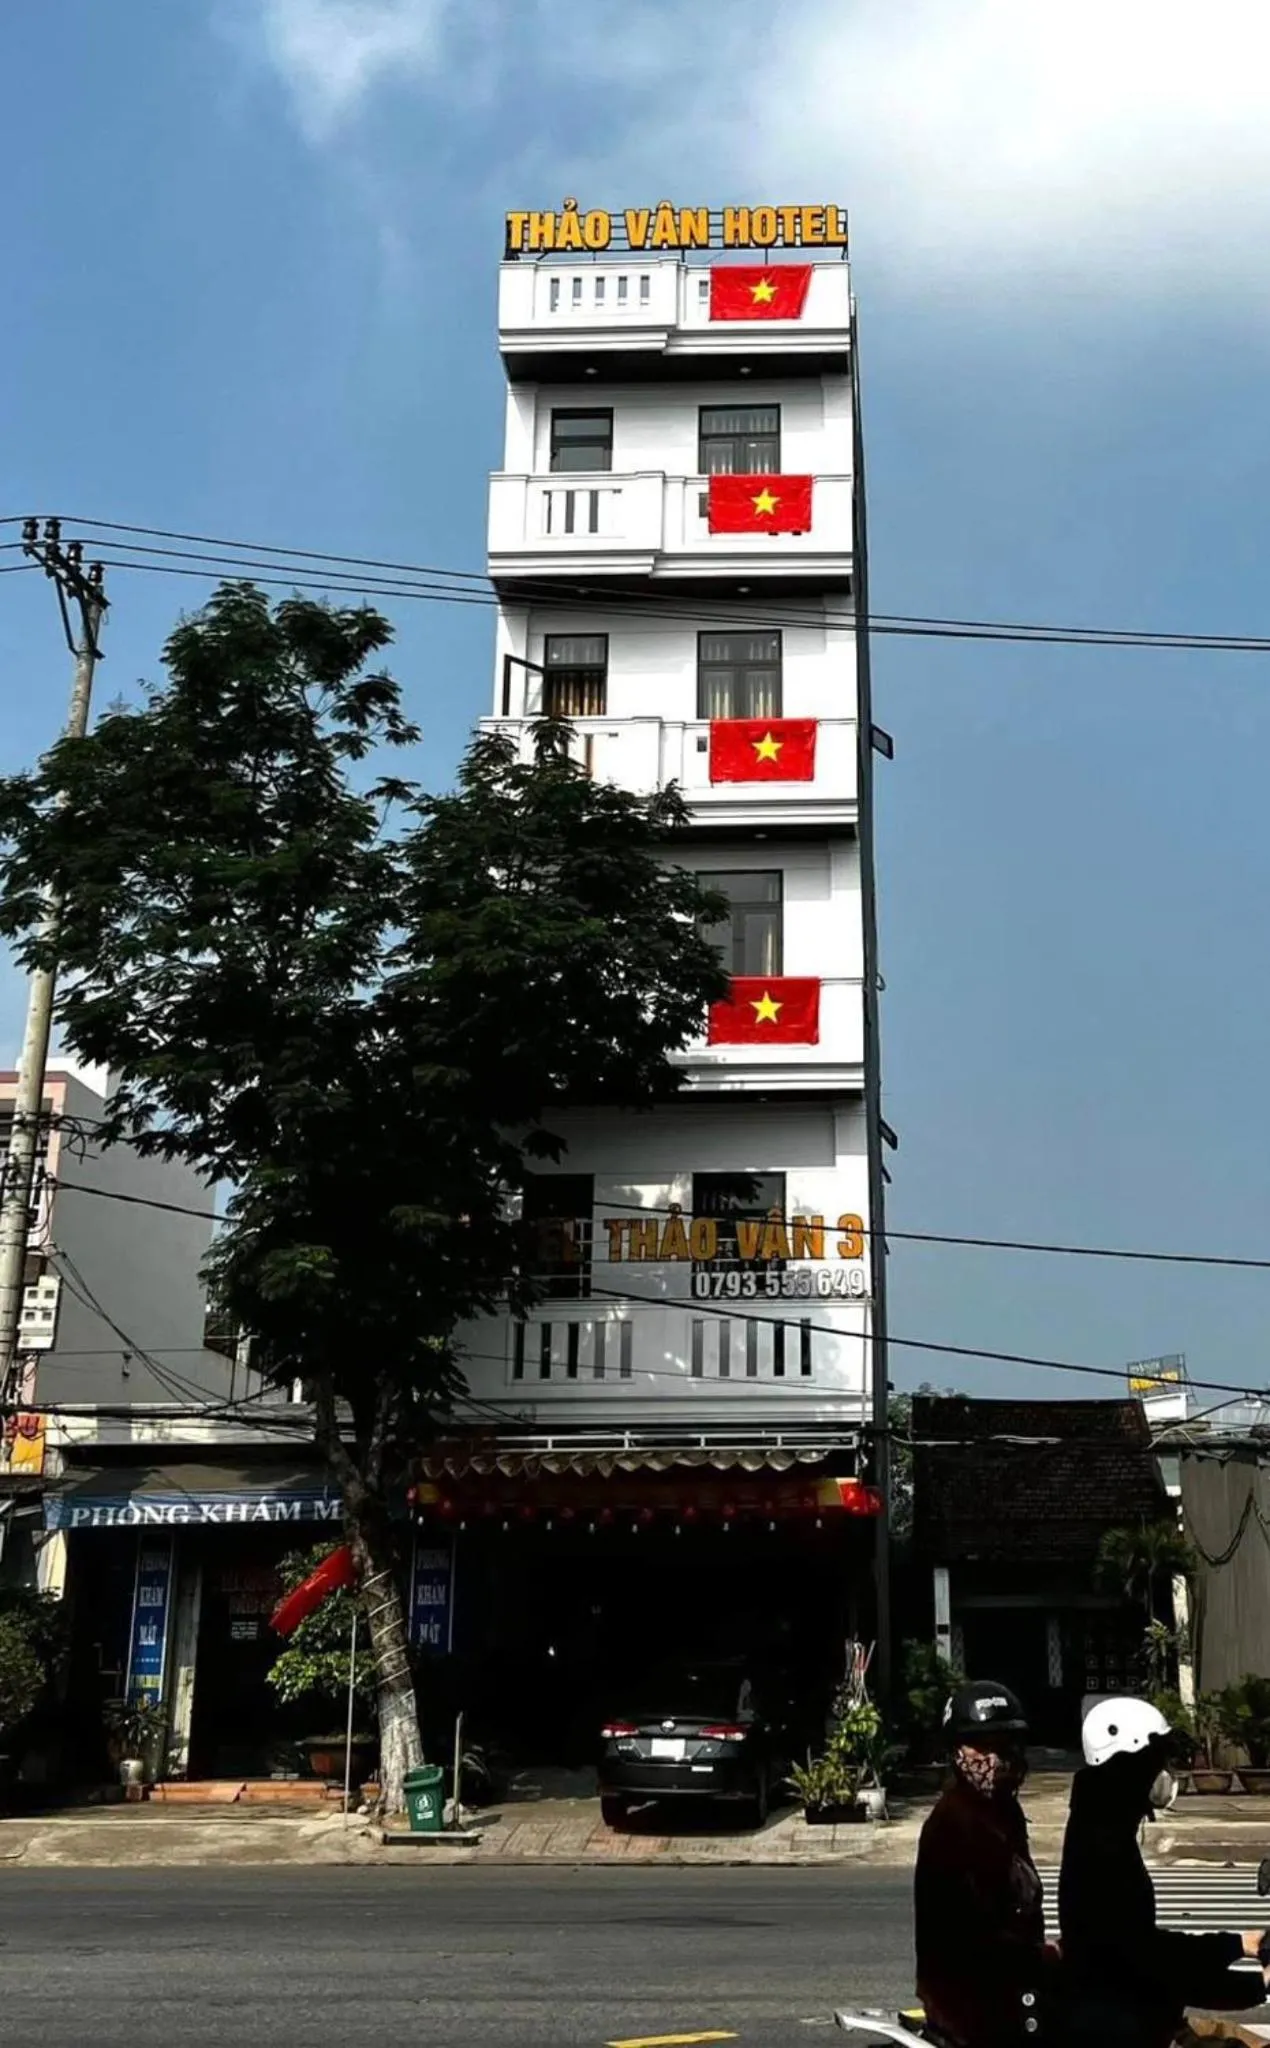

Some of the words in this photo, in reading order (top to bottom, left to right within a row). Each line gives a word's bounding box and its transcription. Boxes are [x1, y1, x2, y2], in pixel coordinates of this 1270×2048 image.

[506, 197, 611, 251] THẢO
[624, 200, 709, 250] VÂN
[722, 205, 847, 249] HOTEL
[604, 1203, 717, 1262] THẢO
[735, 1207, 825, 1261] VÂN
[837, 1213, 864, 1259] 3
[695, 1270, 757, 1298] 0793
[765, 1269, 811, 1297] 555
[817, 1268, 865, 1297] 649
[200, 1496, 301, 1523] KHÁM
